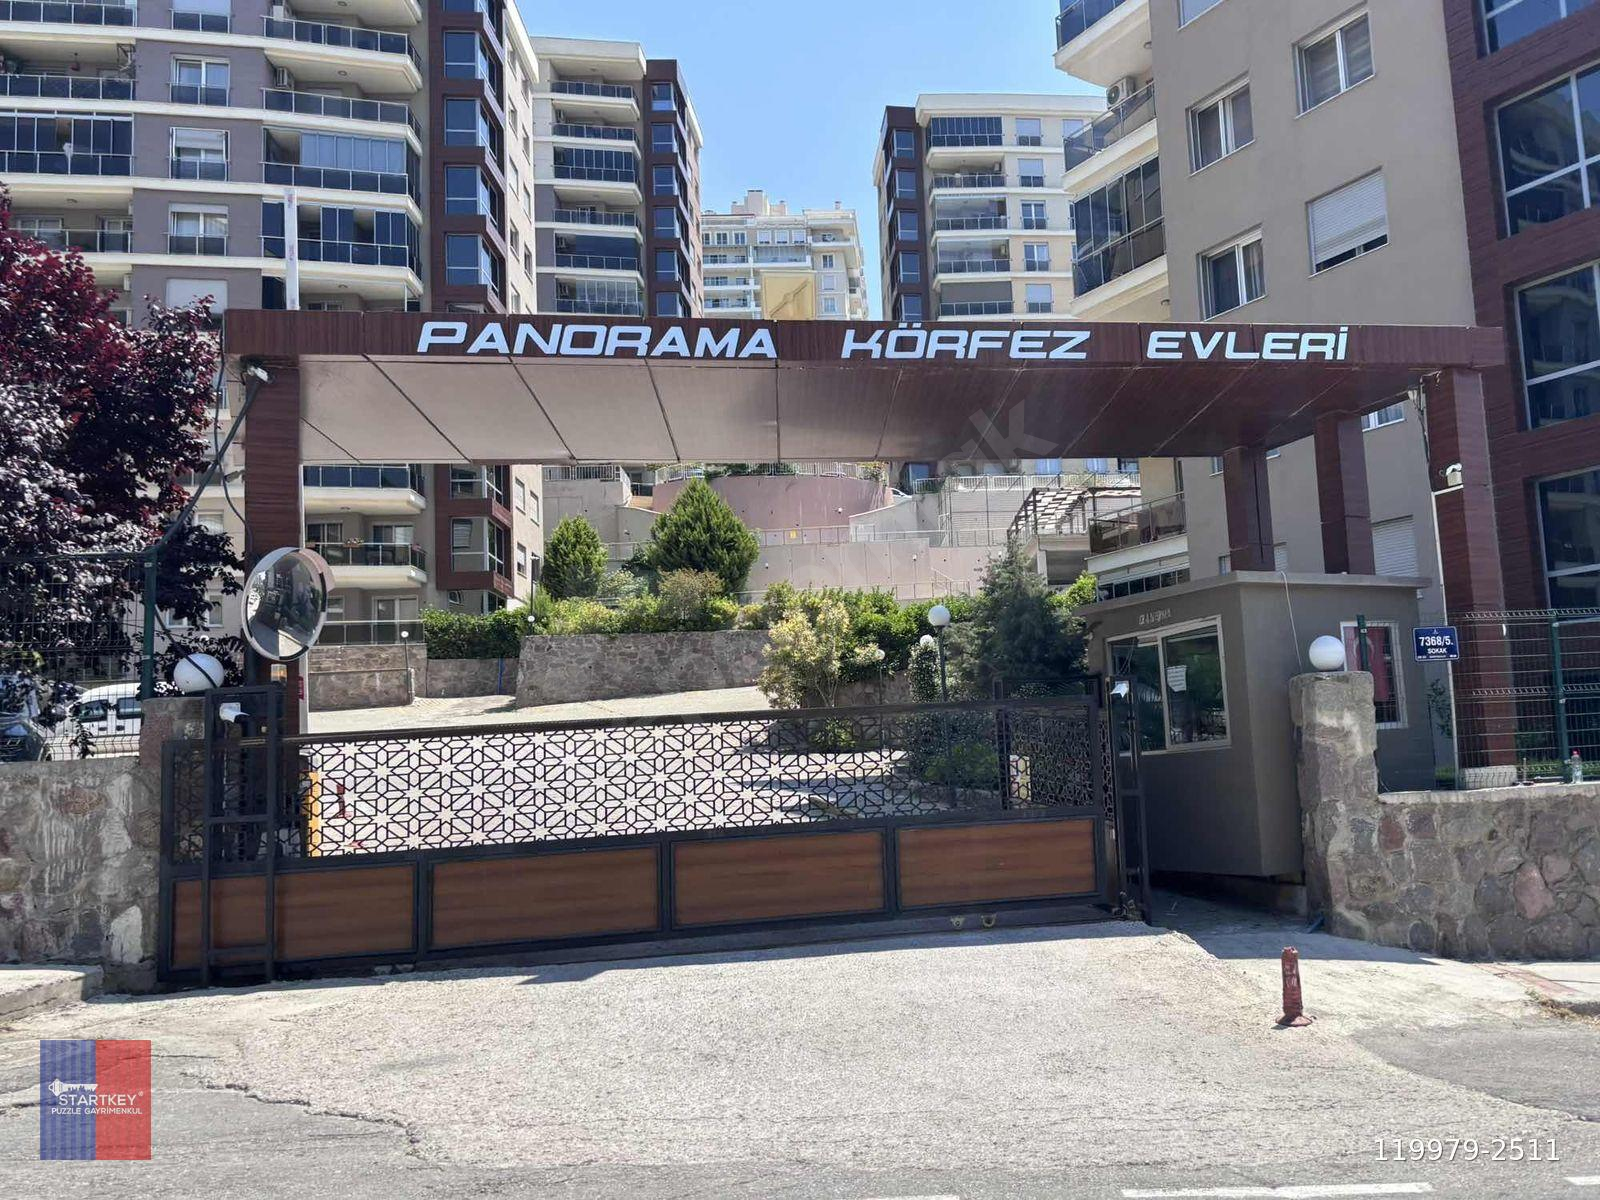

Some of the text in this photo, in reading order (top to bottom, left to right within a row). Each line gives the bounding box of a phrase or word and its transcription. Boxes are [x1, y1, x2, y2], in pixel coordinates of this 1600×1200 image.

[416, 321, 1349, 361] PANORAMA KÖRFEZ EVLERİ
[1427, 647, 1448, 655] SOKAK
